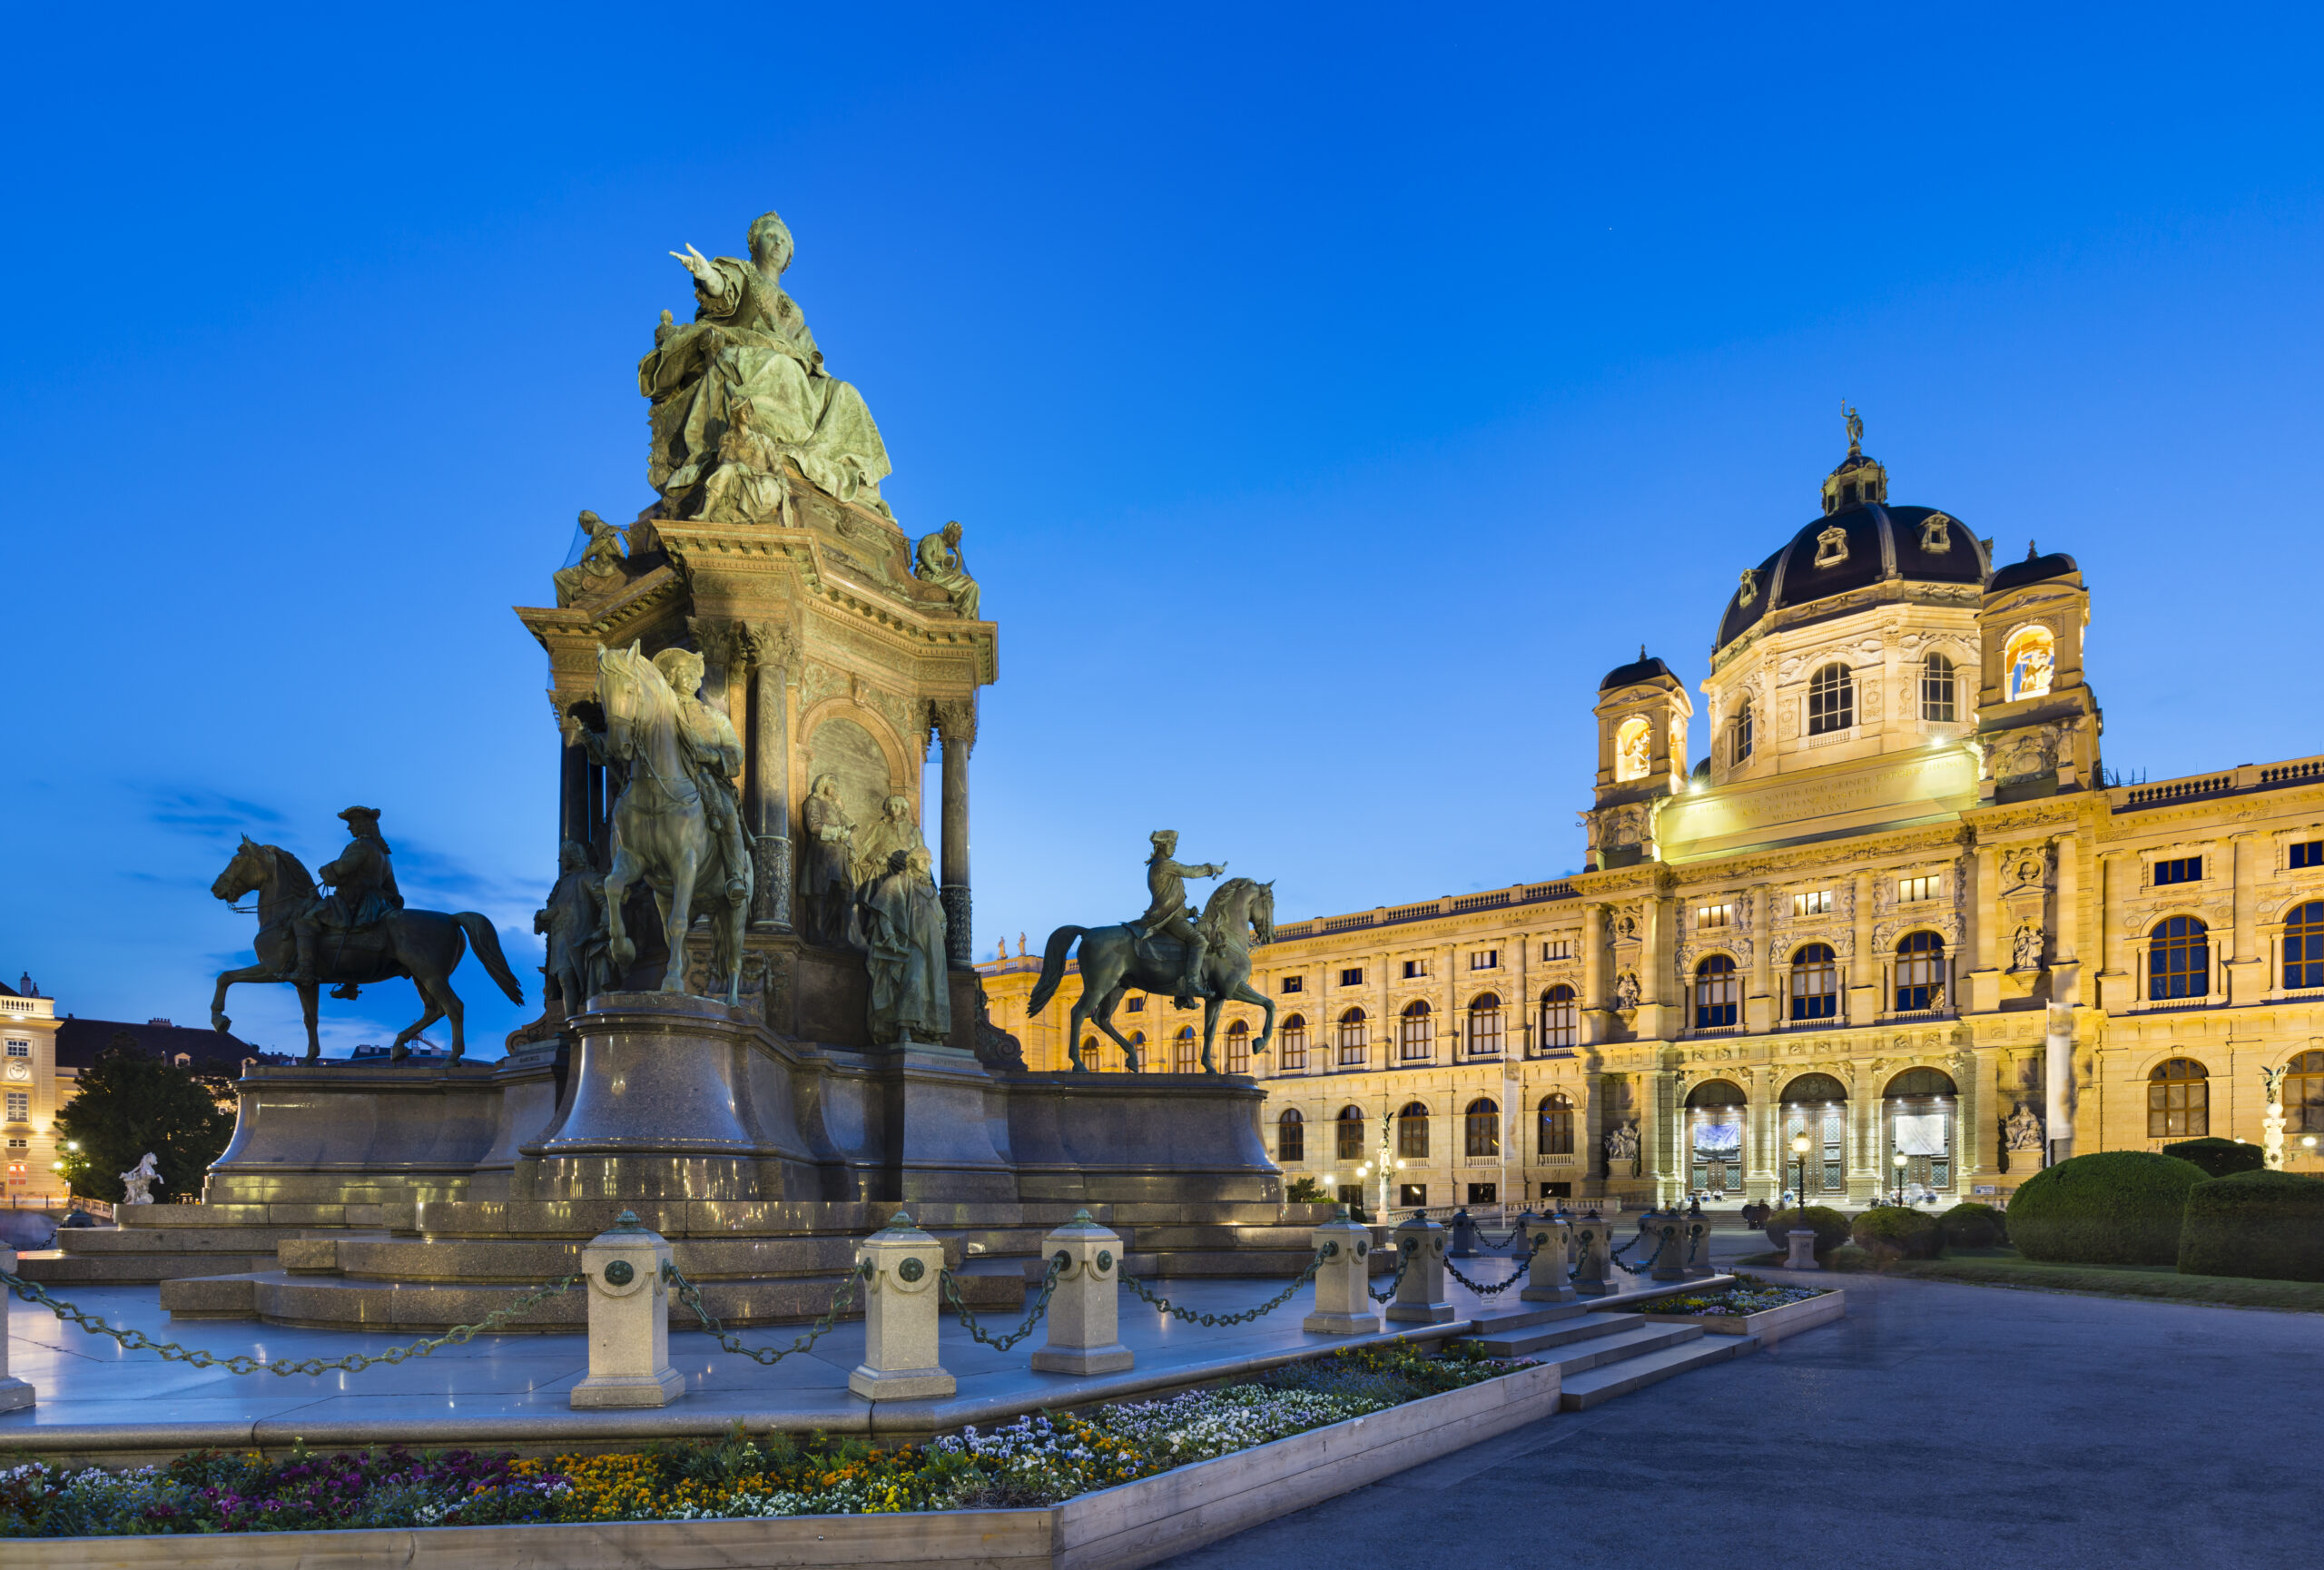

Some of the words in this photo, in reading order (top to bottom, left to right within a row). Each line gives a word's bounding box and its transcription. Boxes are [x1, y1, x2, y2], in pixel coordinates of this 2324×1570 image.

[1765, 789, 1801, 802] NATUR
[1805, 784, 1827, 795] UND
[1831, 776, 1871, 789] SEINER
[1742, 803, 1782, 817] KAISER
[1786, 795, 1821, 809] FRANZ
